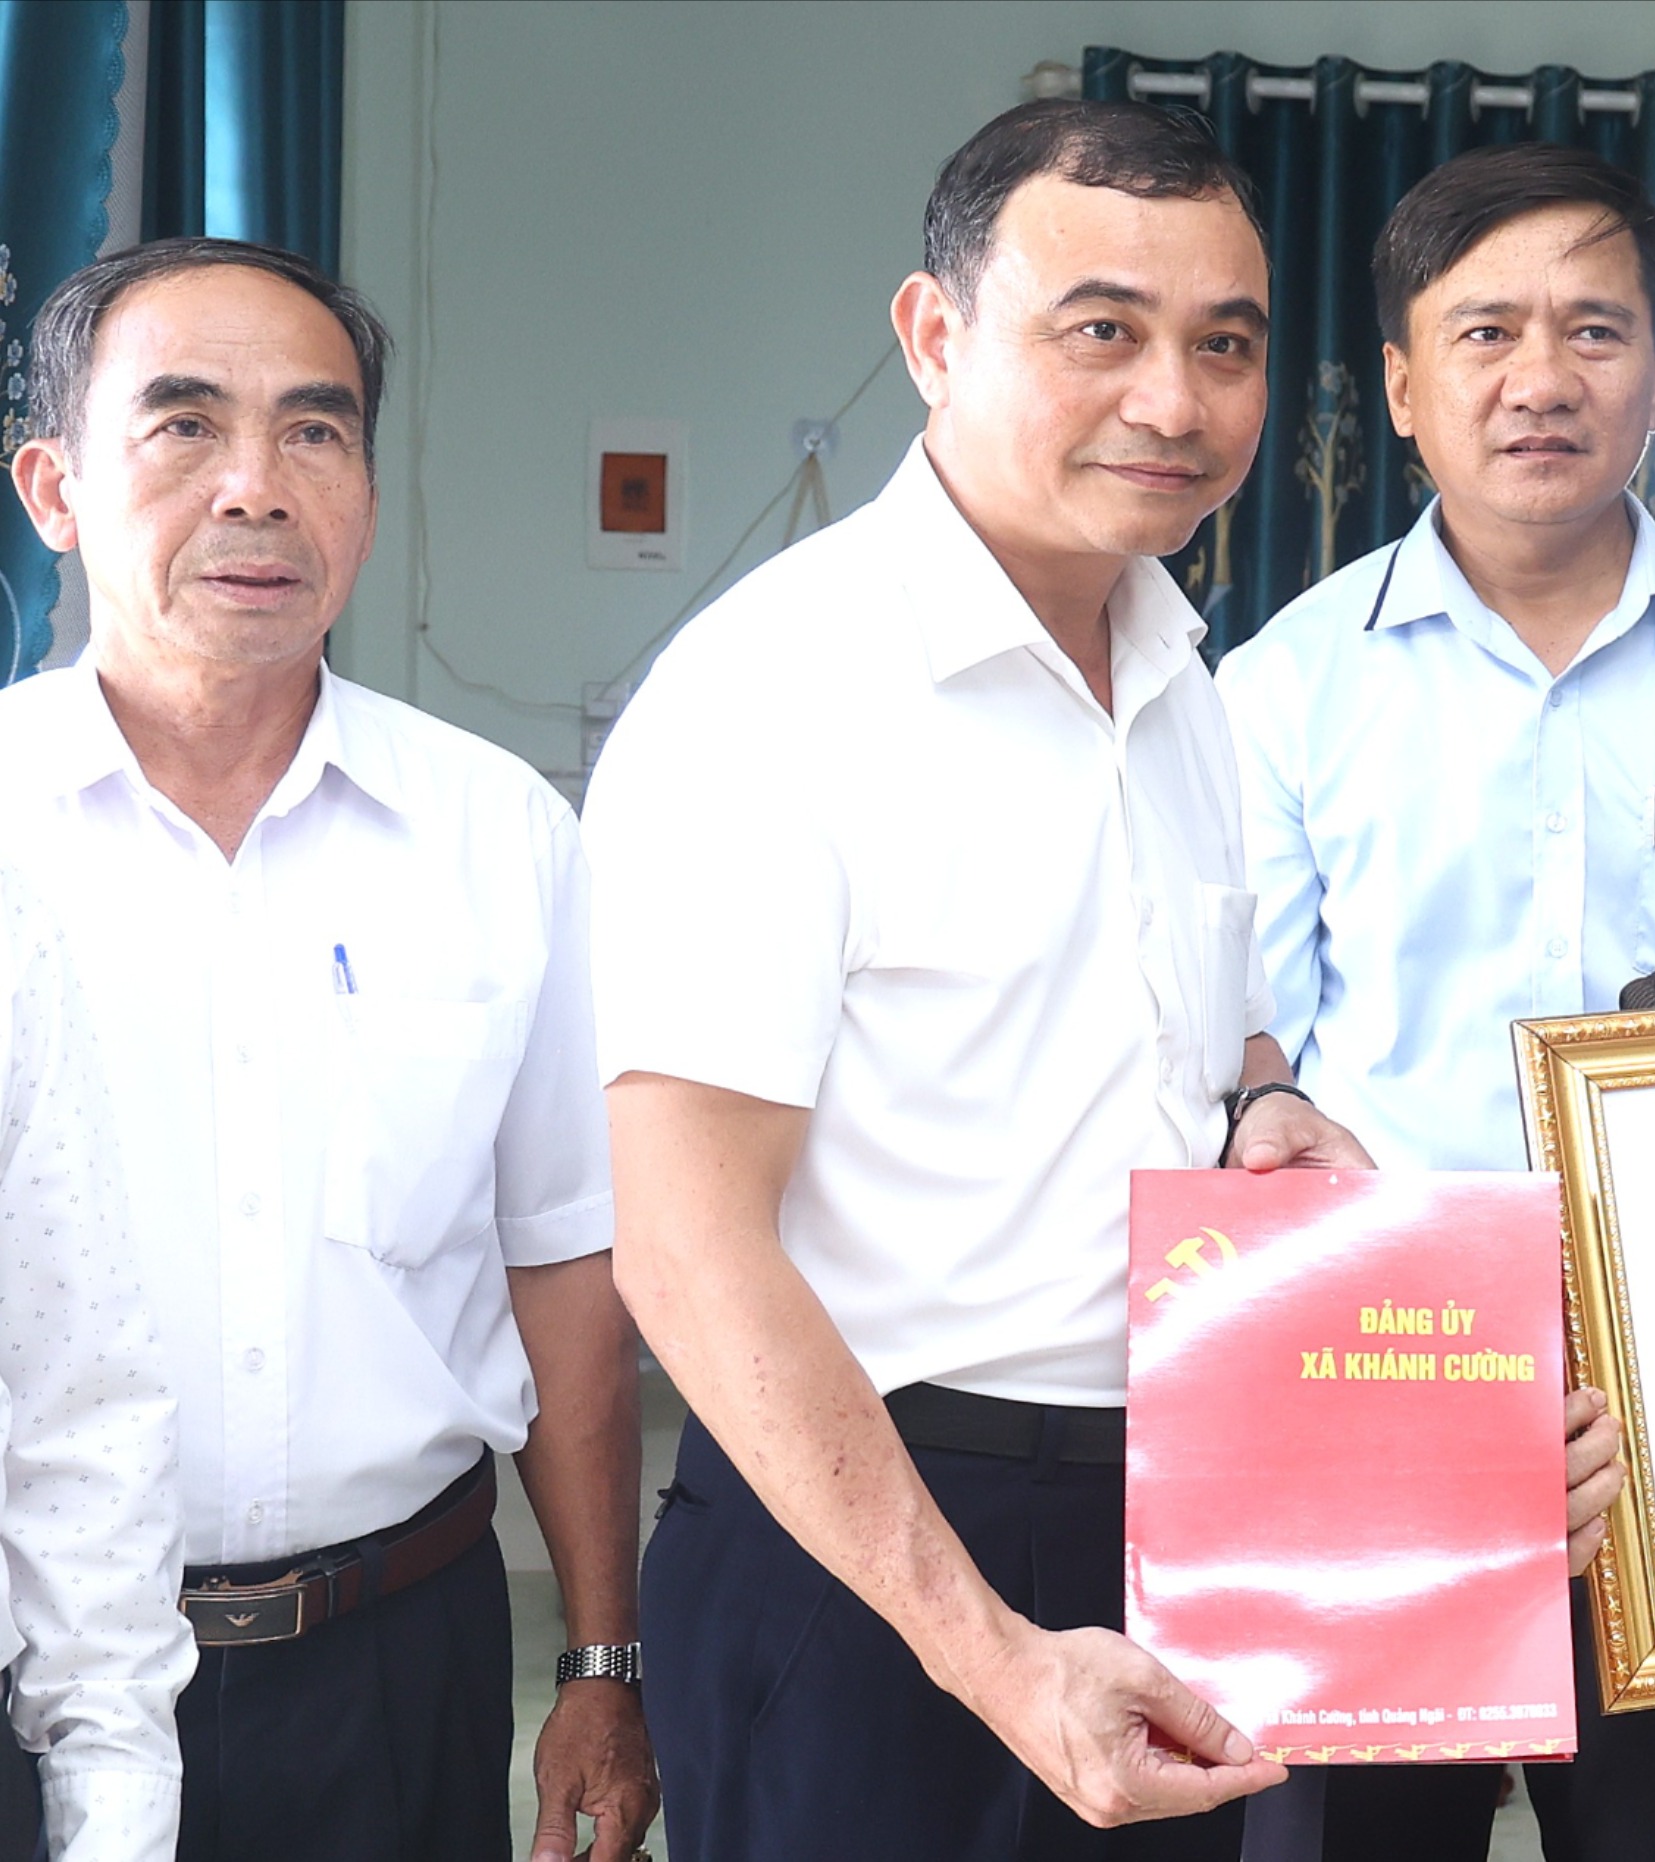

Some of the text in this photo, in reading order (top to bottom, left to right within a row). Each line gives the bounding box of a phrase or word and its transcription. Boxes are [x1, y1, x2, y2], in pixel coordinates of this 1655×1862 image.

[1359, 1298, 1476, 1336] ĐẢNG ỦY
[1301, 1346, 1536, 1383] XÃ KHÁNH CƯỜNG
[1282, 1710, 1316, 1725] Khánh
[1382, 1707, 1417, 1725] Quảng
[1419, 1707, 1445, 1725] Ngãi
